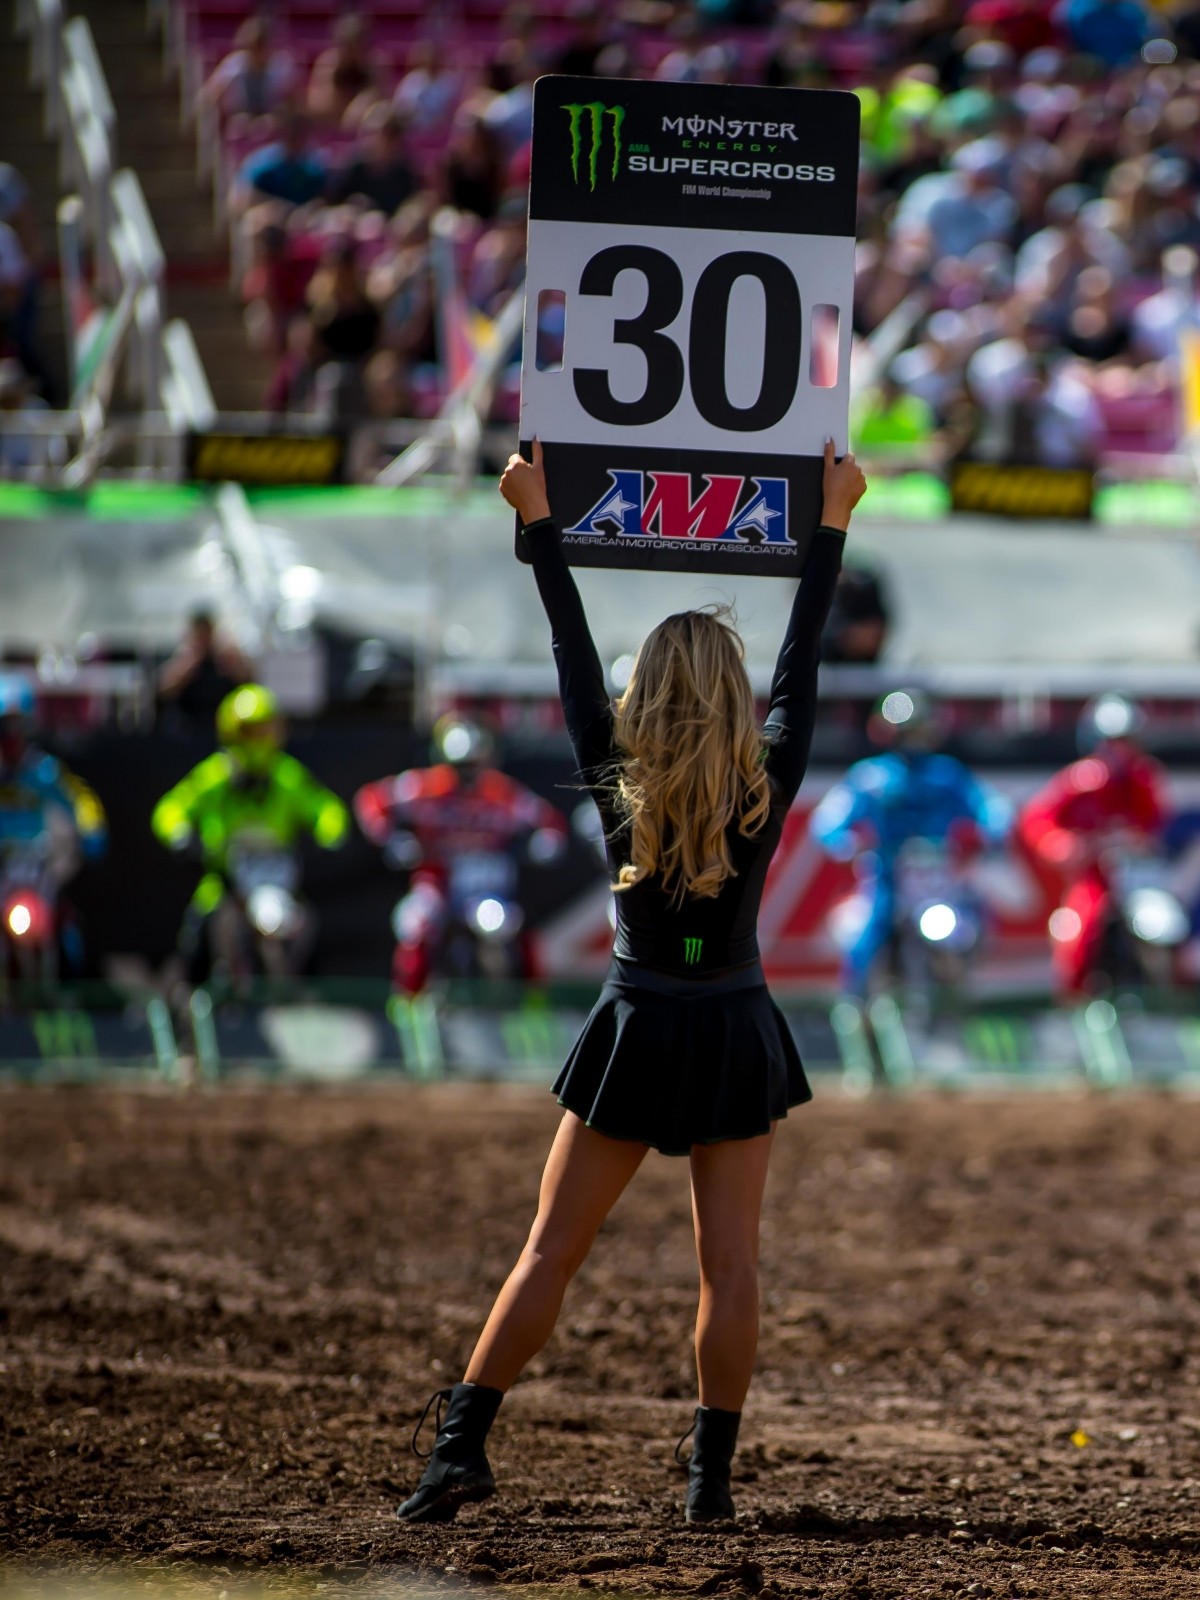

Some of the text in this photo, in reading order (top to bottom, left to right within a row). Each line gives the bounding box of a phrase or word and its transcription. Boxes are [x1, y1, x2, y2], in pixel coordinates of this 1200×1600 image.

[662, 114, 799, 142] MONSTER
[682, 140, 778, 153] ENERGY
[628, 155, 836, 182] SUPERCROSS
[682, 184, 772, 200] FIM World Championship
[572, 244, 803, 432] 30
[562, 468, 798, 546] AMA
[562, 535, 798, 556] AMERICAN MOTORCYCLIST ASSOCIATION
